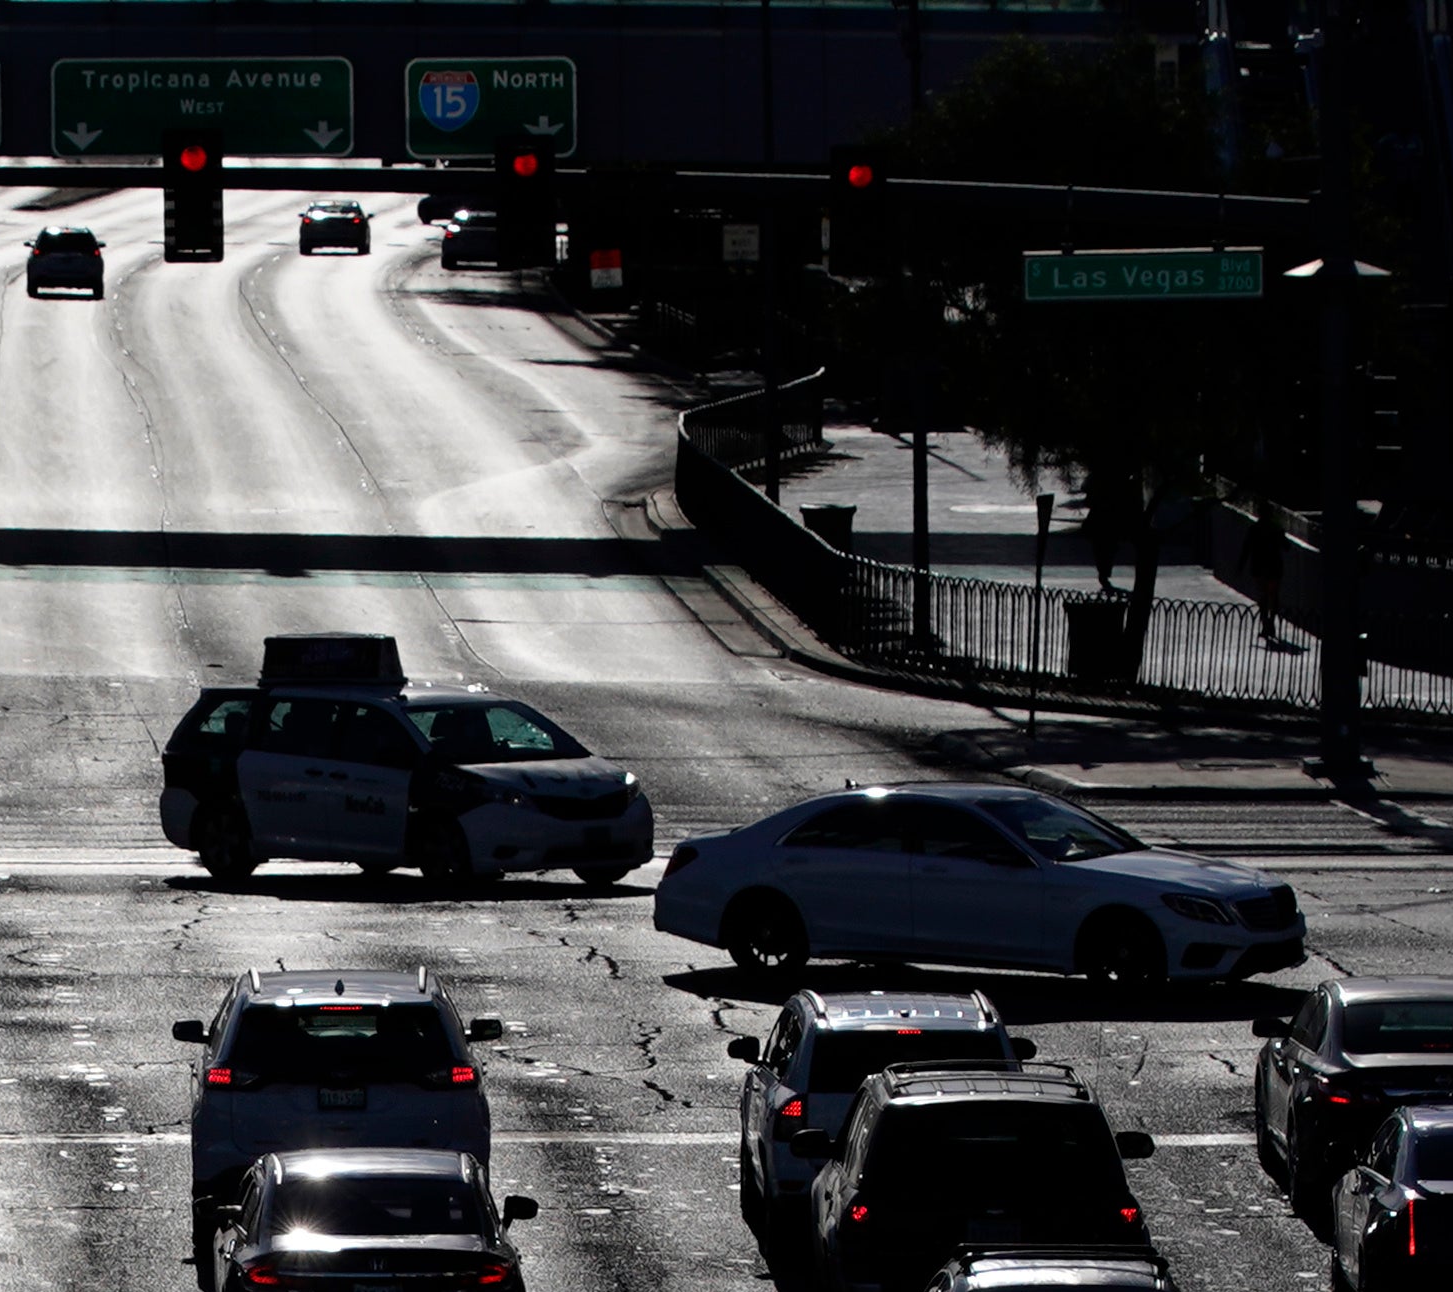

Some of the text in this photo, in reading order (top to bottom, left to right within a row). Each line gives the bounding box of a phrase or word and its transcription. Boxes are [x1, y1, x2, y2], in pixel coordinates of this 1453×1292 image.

[81, 68, 322, 93] Tropicana Avenue
[493, 69, 565, 88] NORTH
[180, 98, 224, 114] WEST
[433, 85, 467, 119] 15
[1053, 266, 1107, 289] Las
[1122, 265, 1205, 293] Vegas
[1221, 257, 1251, 273] Blvd
[1218, 275, 1254, 291] 3700
